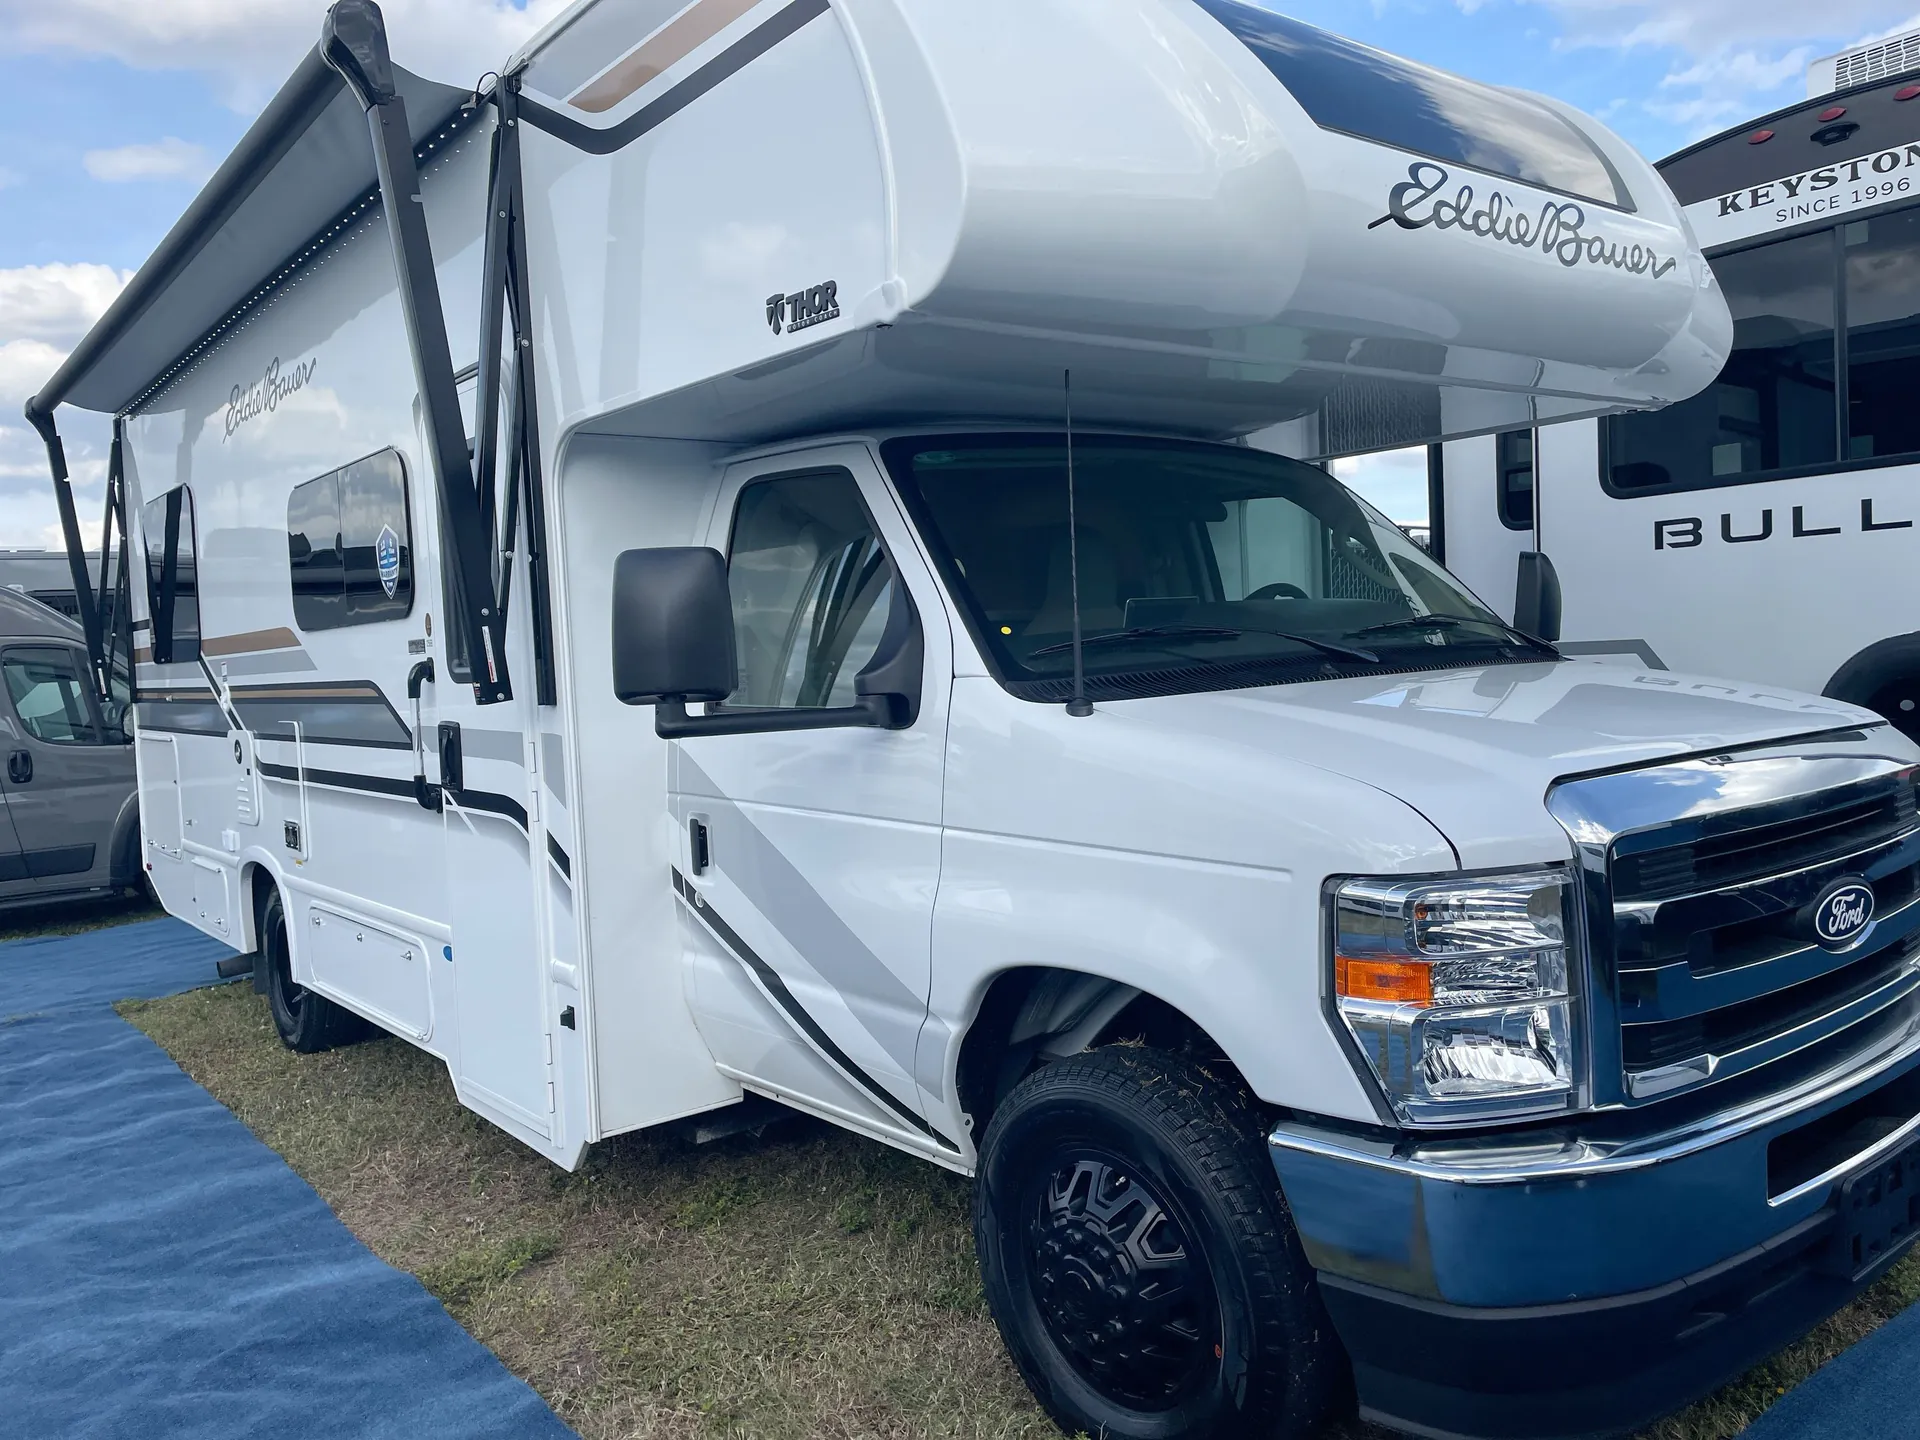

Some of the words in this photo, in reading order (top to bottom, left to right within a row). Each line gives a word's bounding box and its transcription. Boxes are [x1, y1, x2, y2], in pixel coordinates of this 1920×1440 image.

[1367, 161, 1537, 248] Eddie
[1538, 200, 1676, 279] Bauer
[1776, 194, 1841, 223] SINCE
[1851, 177, 1911, 204] 1996
[785, 279, 839, 323] THOR
[814, 309, 838, 323] COACH
[222, 383, 262, 444] Eddie
[262, 356, 316, 413] Bauer
[1654, 498, 1913, 550] BULL
[1828, 892, 1865, 934] Ford
